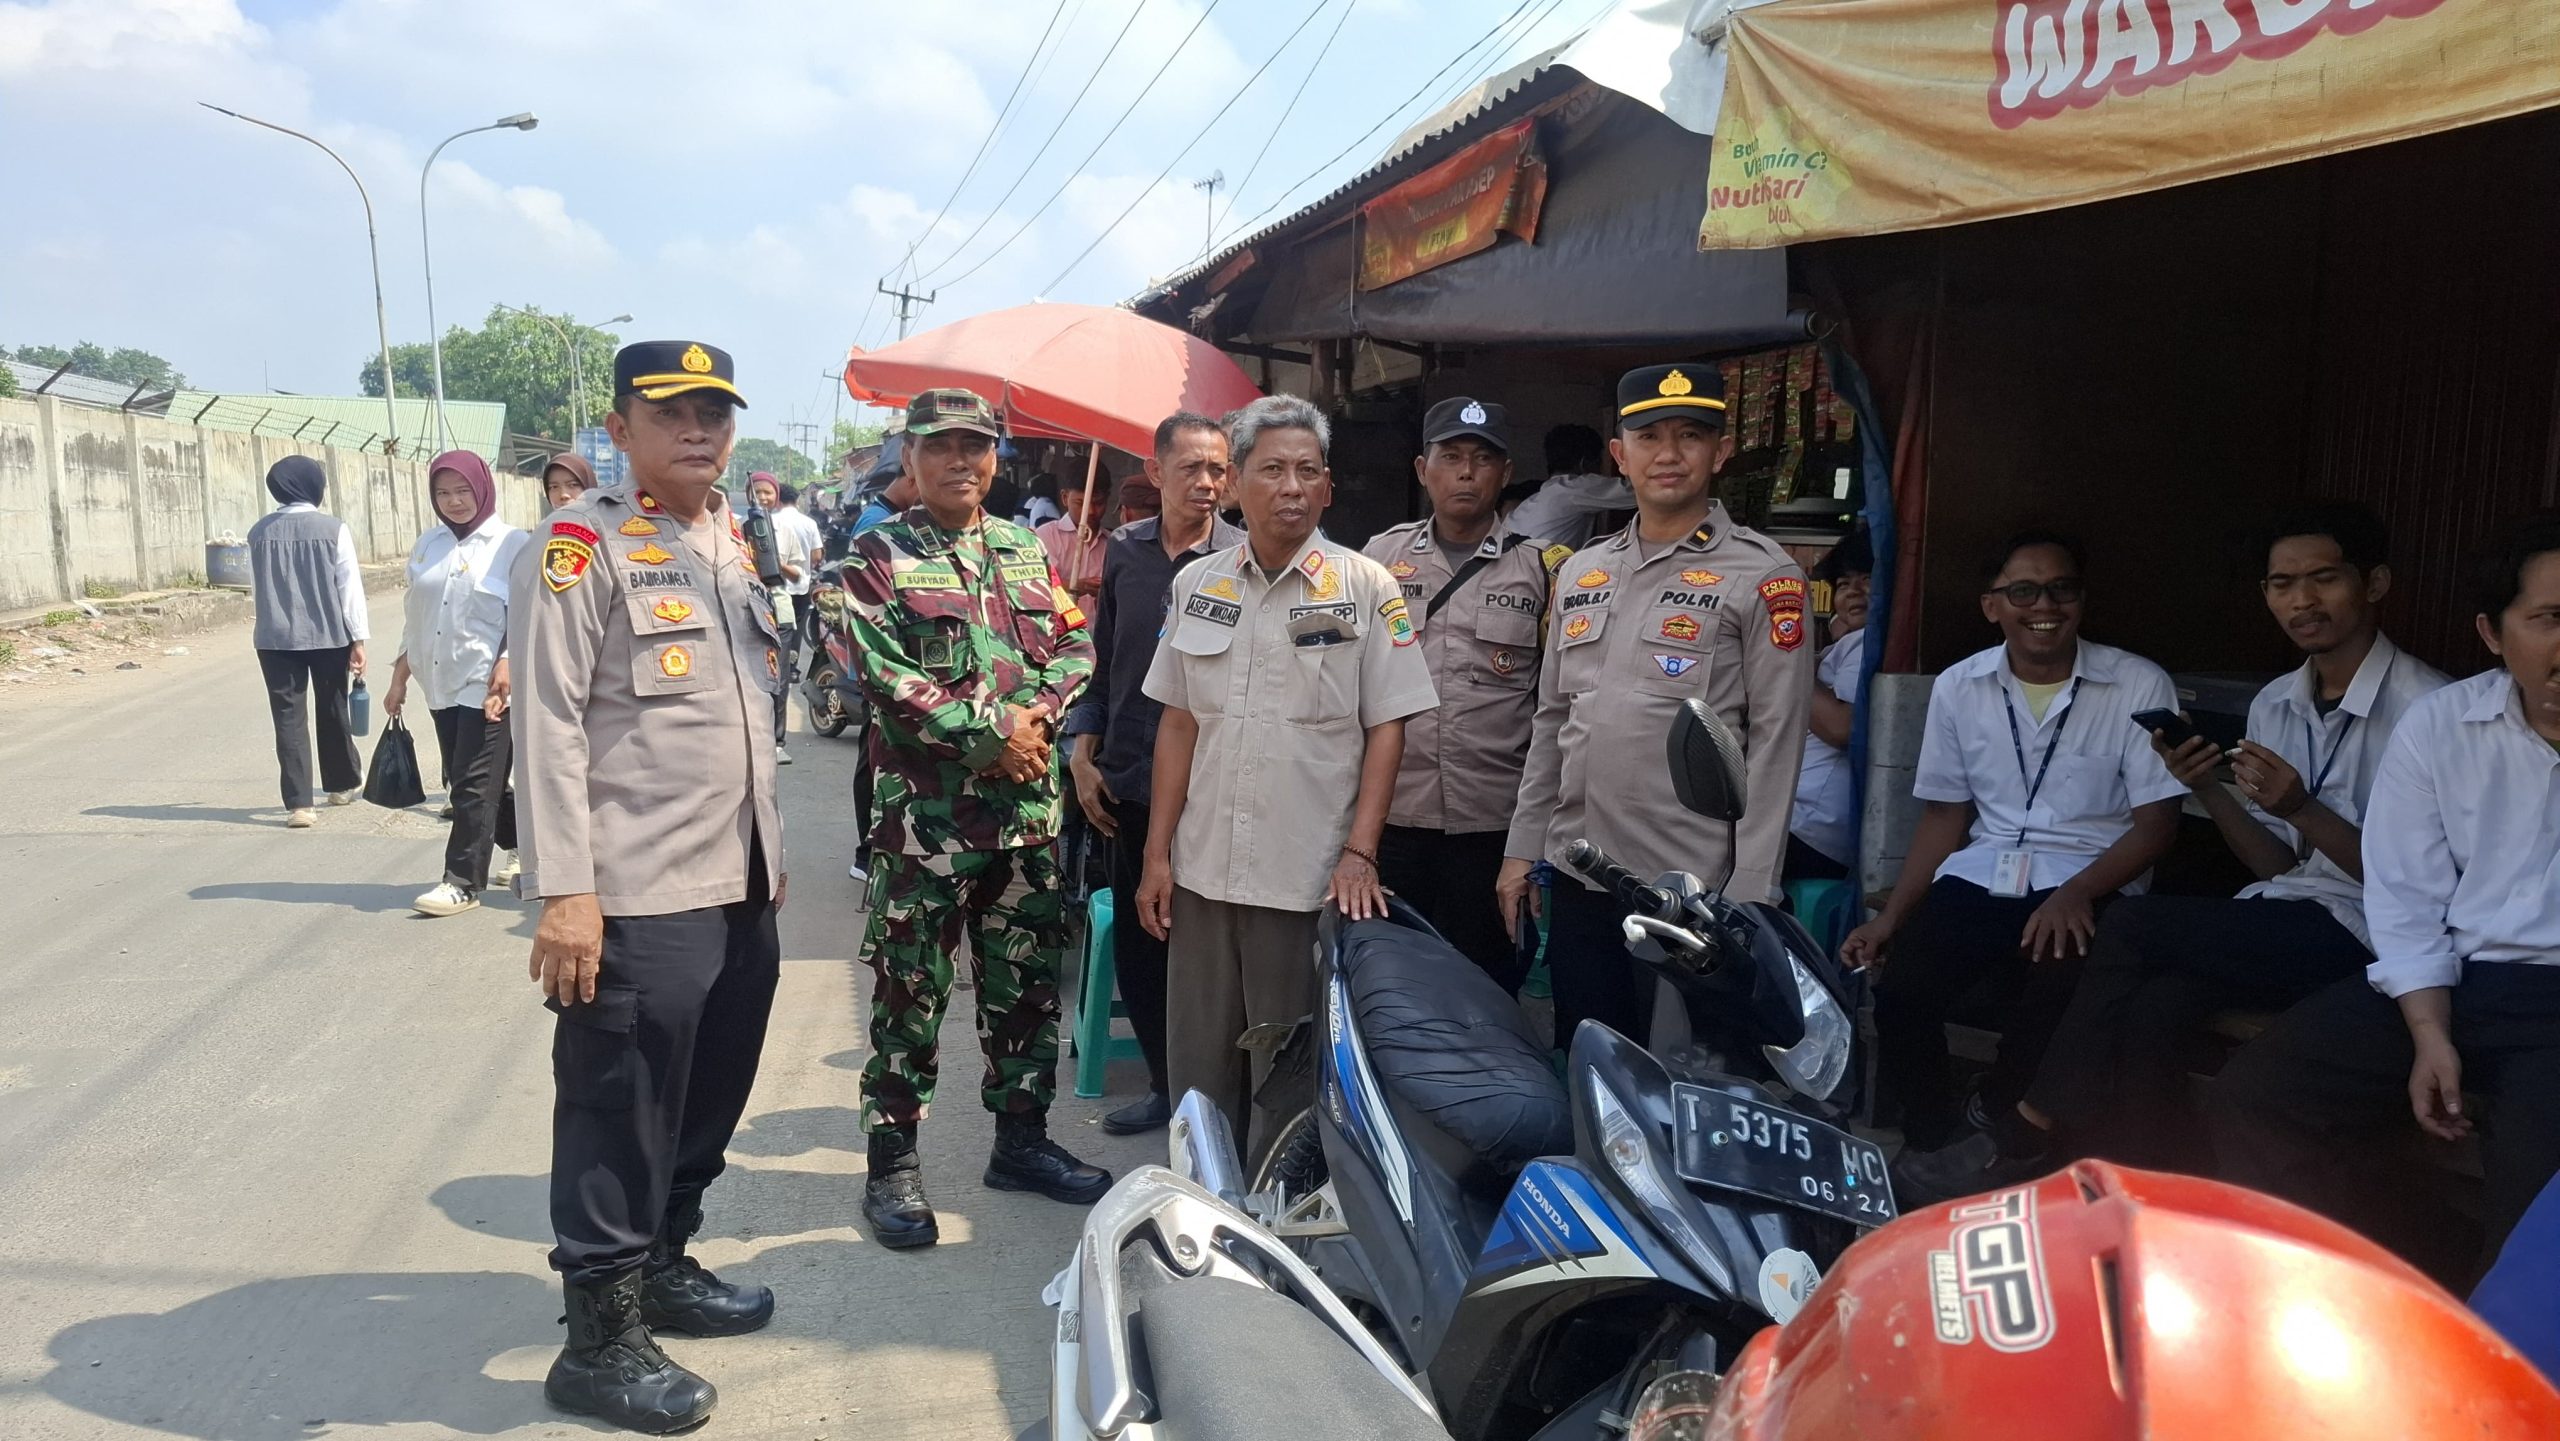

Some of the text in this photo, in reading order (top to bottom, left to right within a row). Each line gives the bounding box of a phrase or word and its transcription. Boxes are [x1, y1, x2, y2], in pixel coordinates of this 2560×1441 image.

[906, 576, 950, 586] SURYADI
[1399, 583, 1423, 598] TOM
[1188, 598, 1210, 615] ASEP
[1485, 593, 1536, 614] POLRI
[1660, 590, 1720, 610] POLRI
[1679, 1092, 1700, 1132] T
[1730, 1102, 1812, 1162] 5375
[1522, 1175, 1570, 1240] HONDA
[1933, 1252, 1967, 1340] HELMETS
